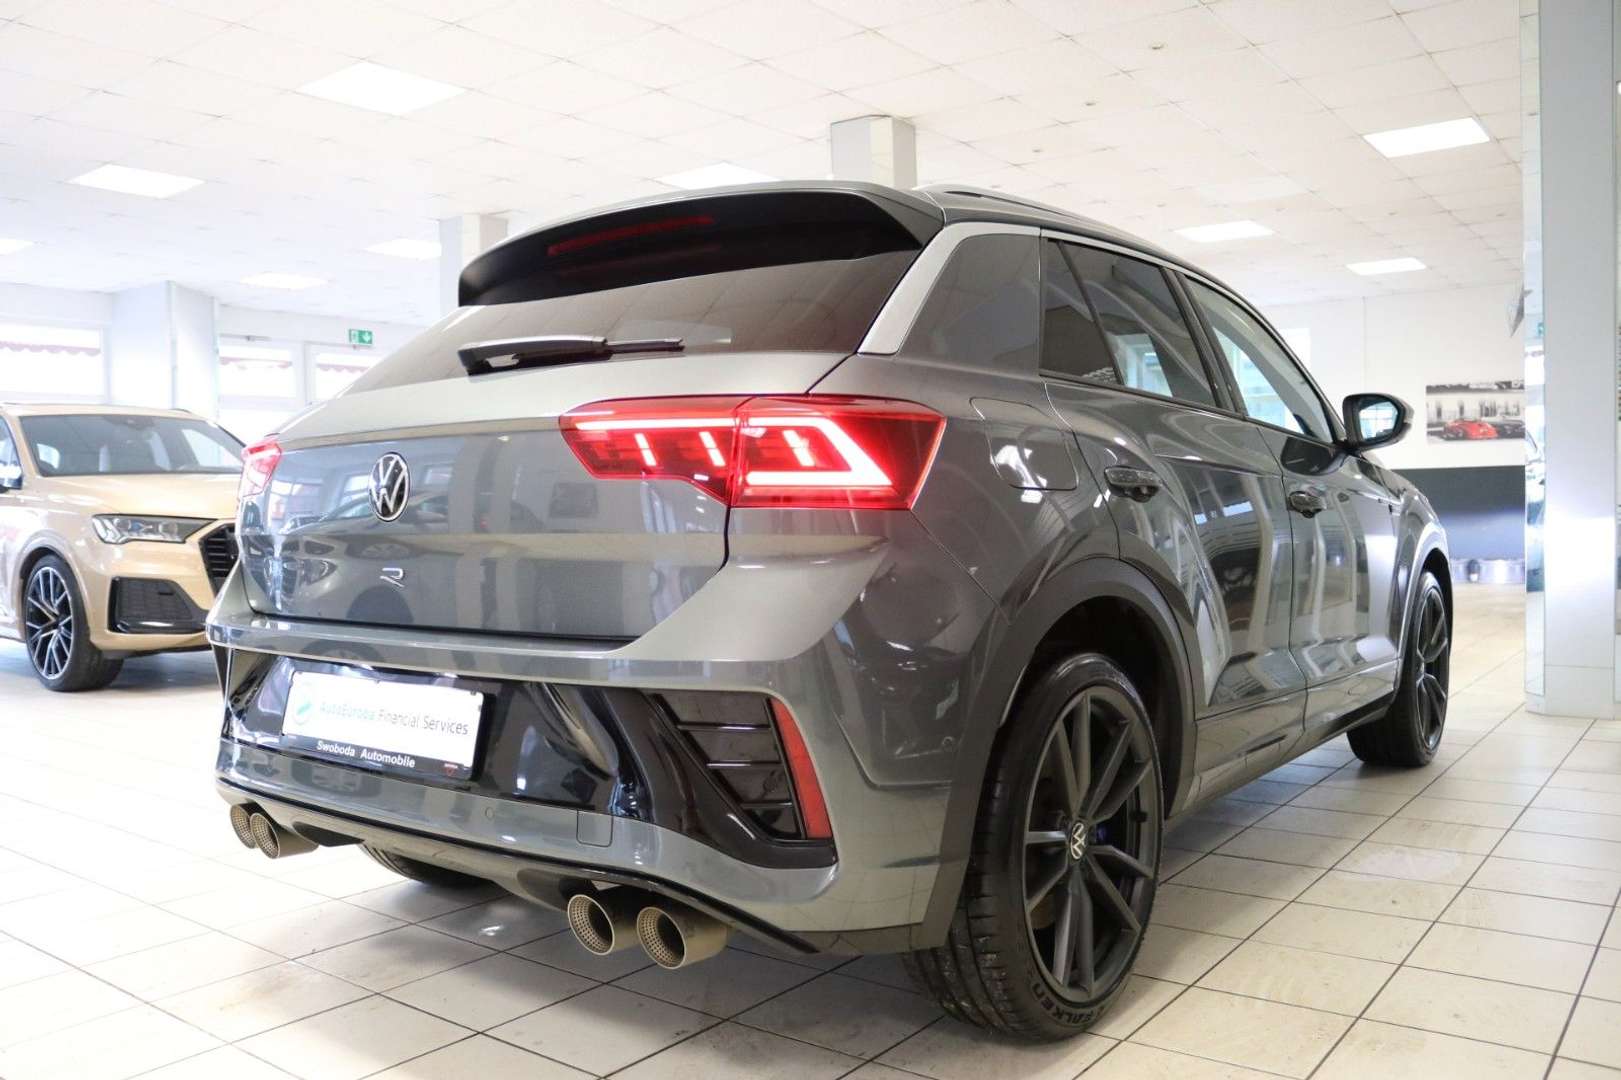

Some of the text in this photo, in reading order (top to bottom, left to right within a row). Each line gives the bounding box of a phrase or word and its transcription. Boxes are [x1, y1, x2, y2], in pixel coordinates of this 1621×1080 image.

[379, 708, 420, 729] Financial
[423, 715, 469, 736] Services
[316, 740, 416, 768] Swoboda Automobile
